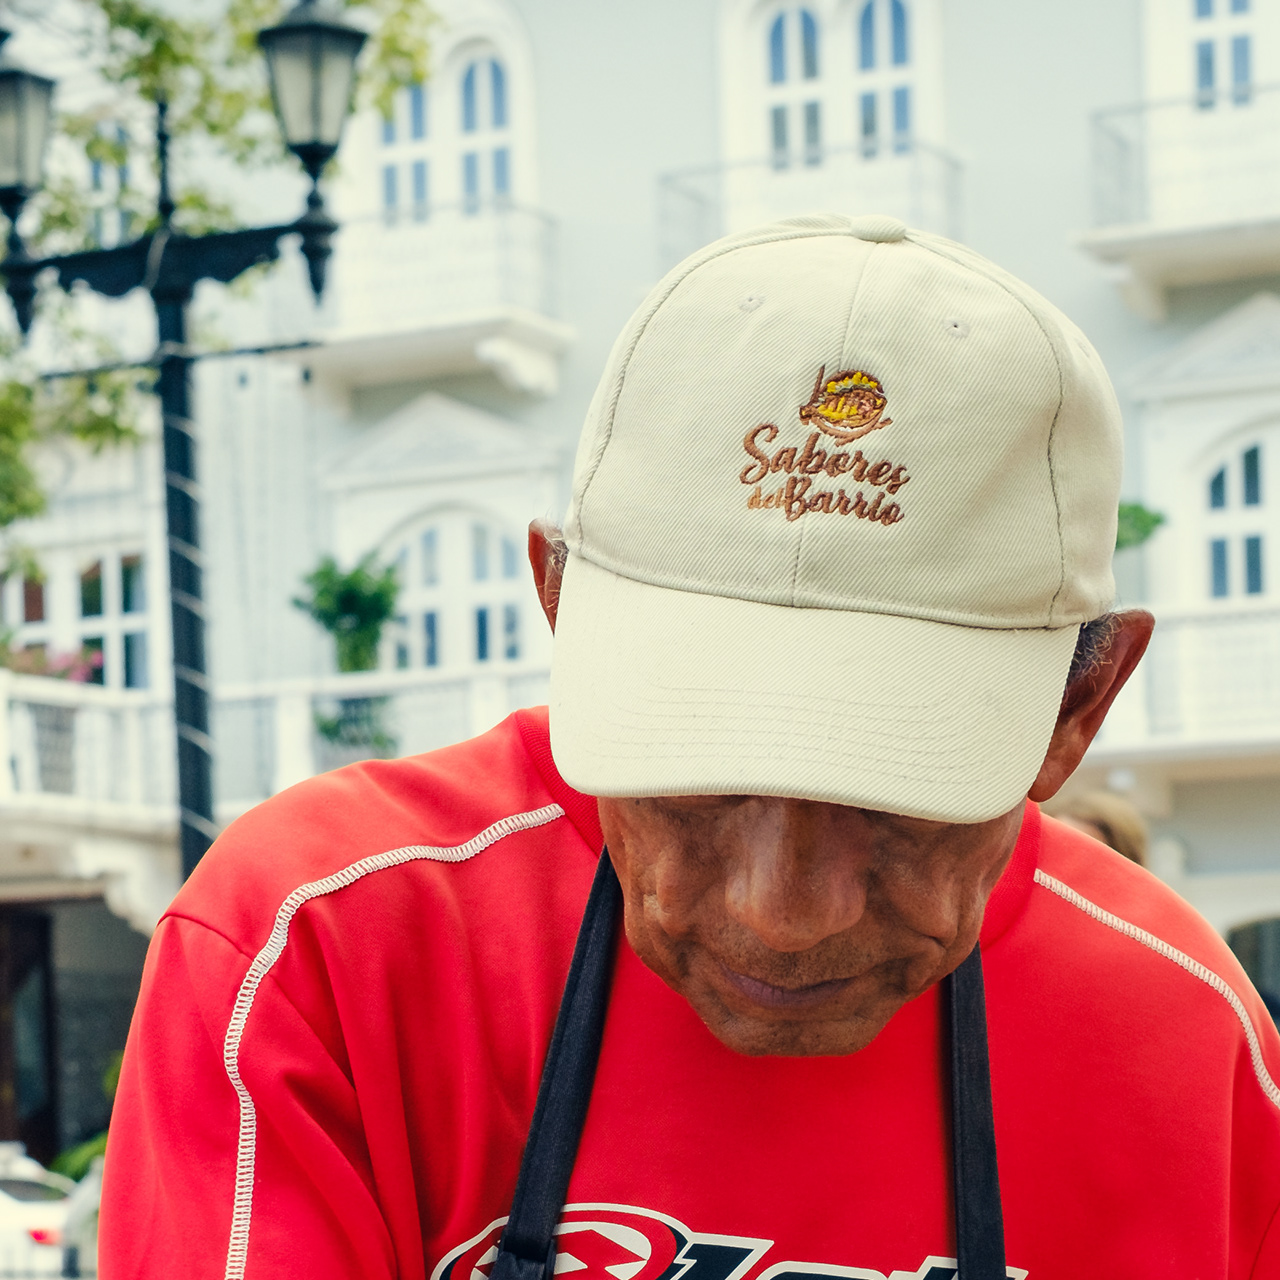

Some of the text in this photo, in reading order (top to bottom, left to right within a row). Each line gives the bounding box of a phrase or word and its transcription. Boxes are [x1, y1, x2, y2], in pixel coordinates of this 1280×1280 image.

[739, 421, 911, 495] Sabores
[747, 475, 905, 526] del Barrio
